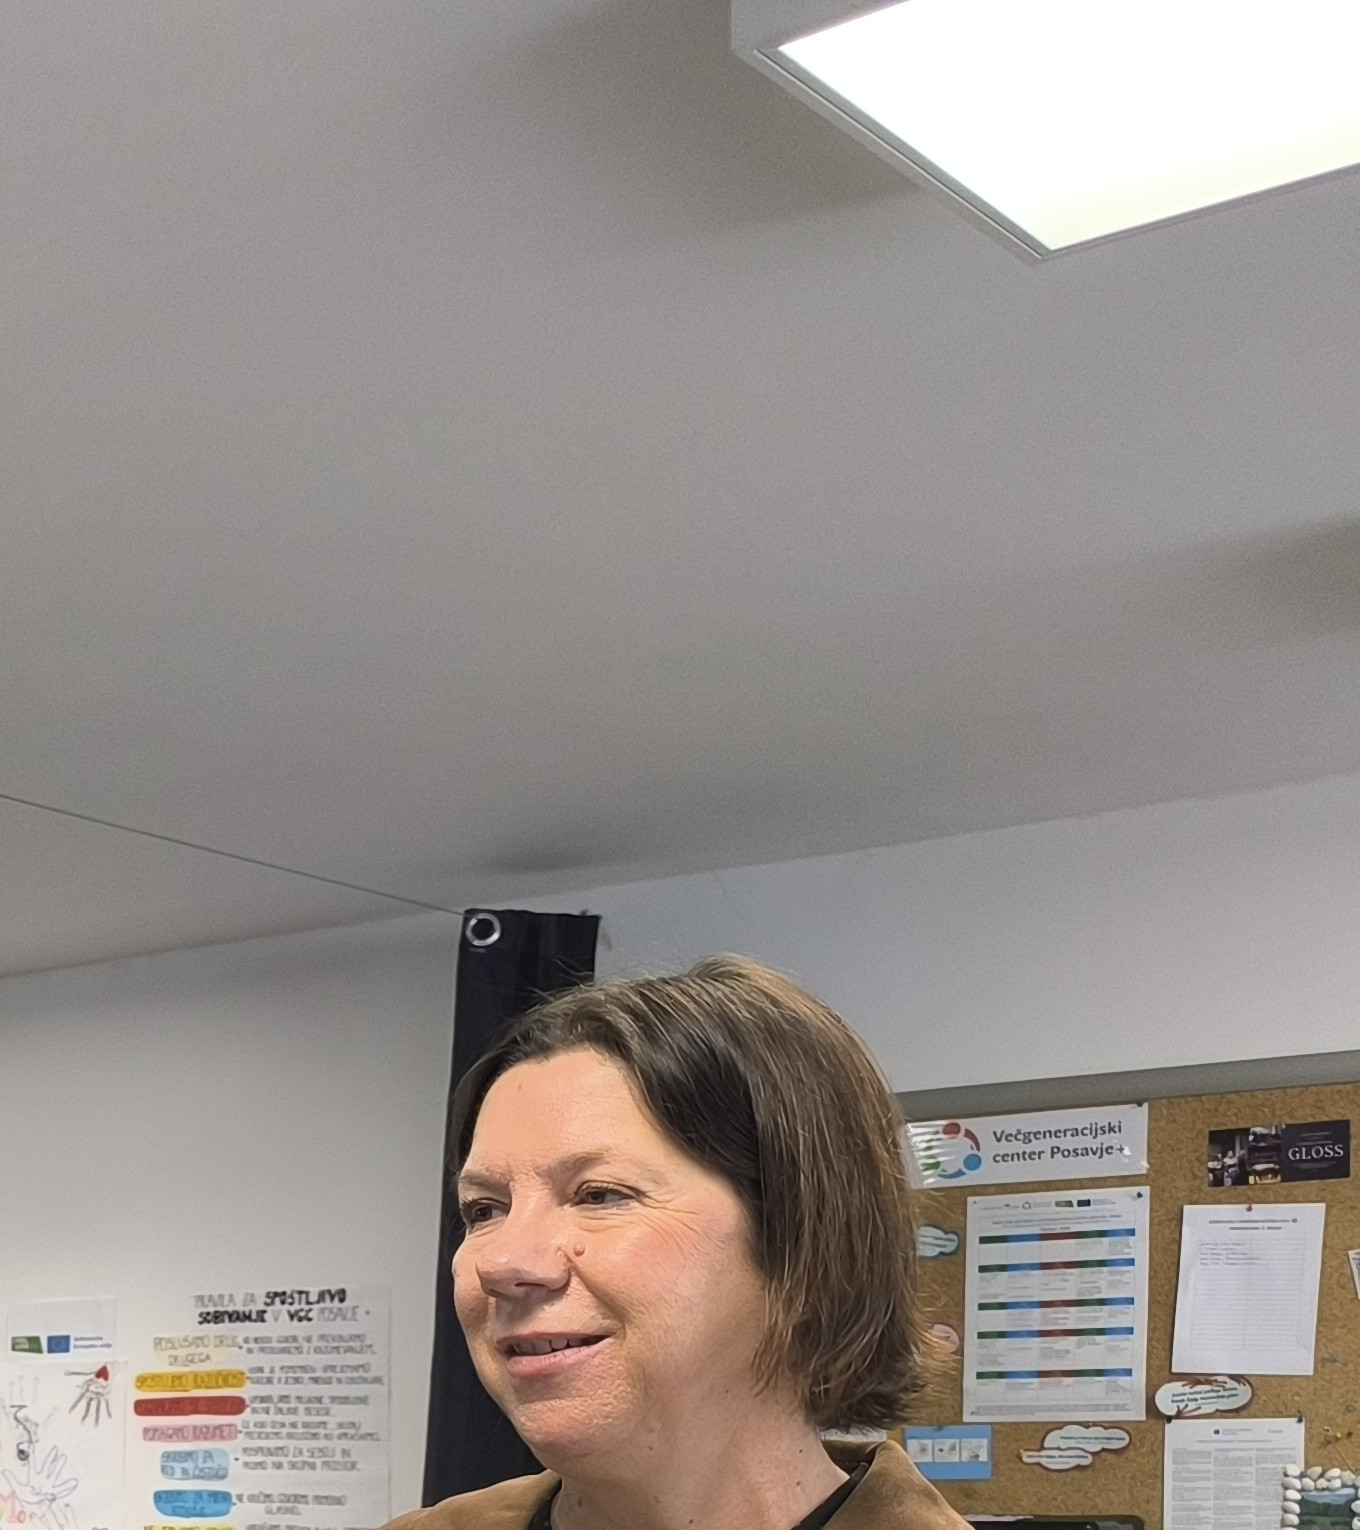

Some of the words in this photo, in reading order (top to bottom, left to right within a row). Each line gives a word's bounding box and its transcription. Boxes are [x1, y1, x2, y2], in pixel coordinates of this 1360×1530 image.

[992, 1119, 1123, 1145] Večgeneracijski
[992, 1148, 1046, 1164] center
[1287, 1143, 1345, 1161] GLOSS
